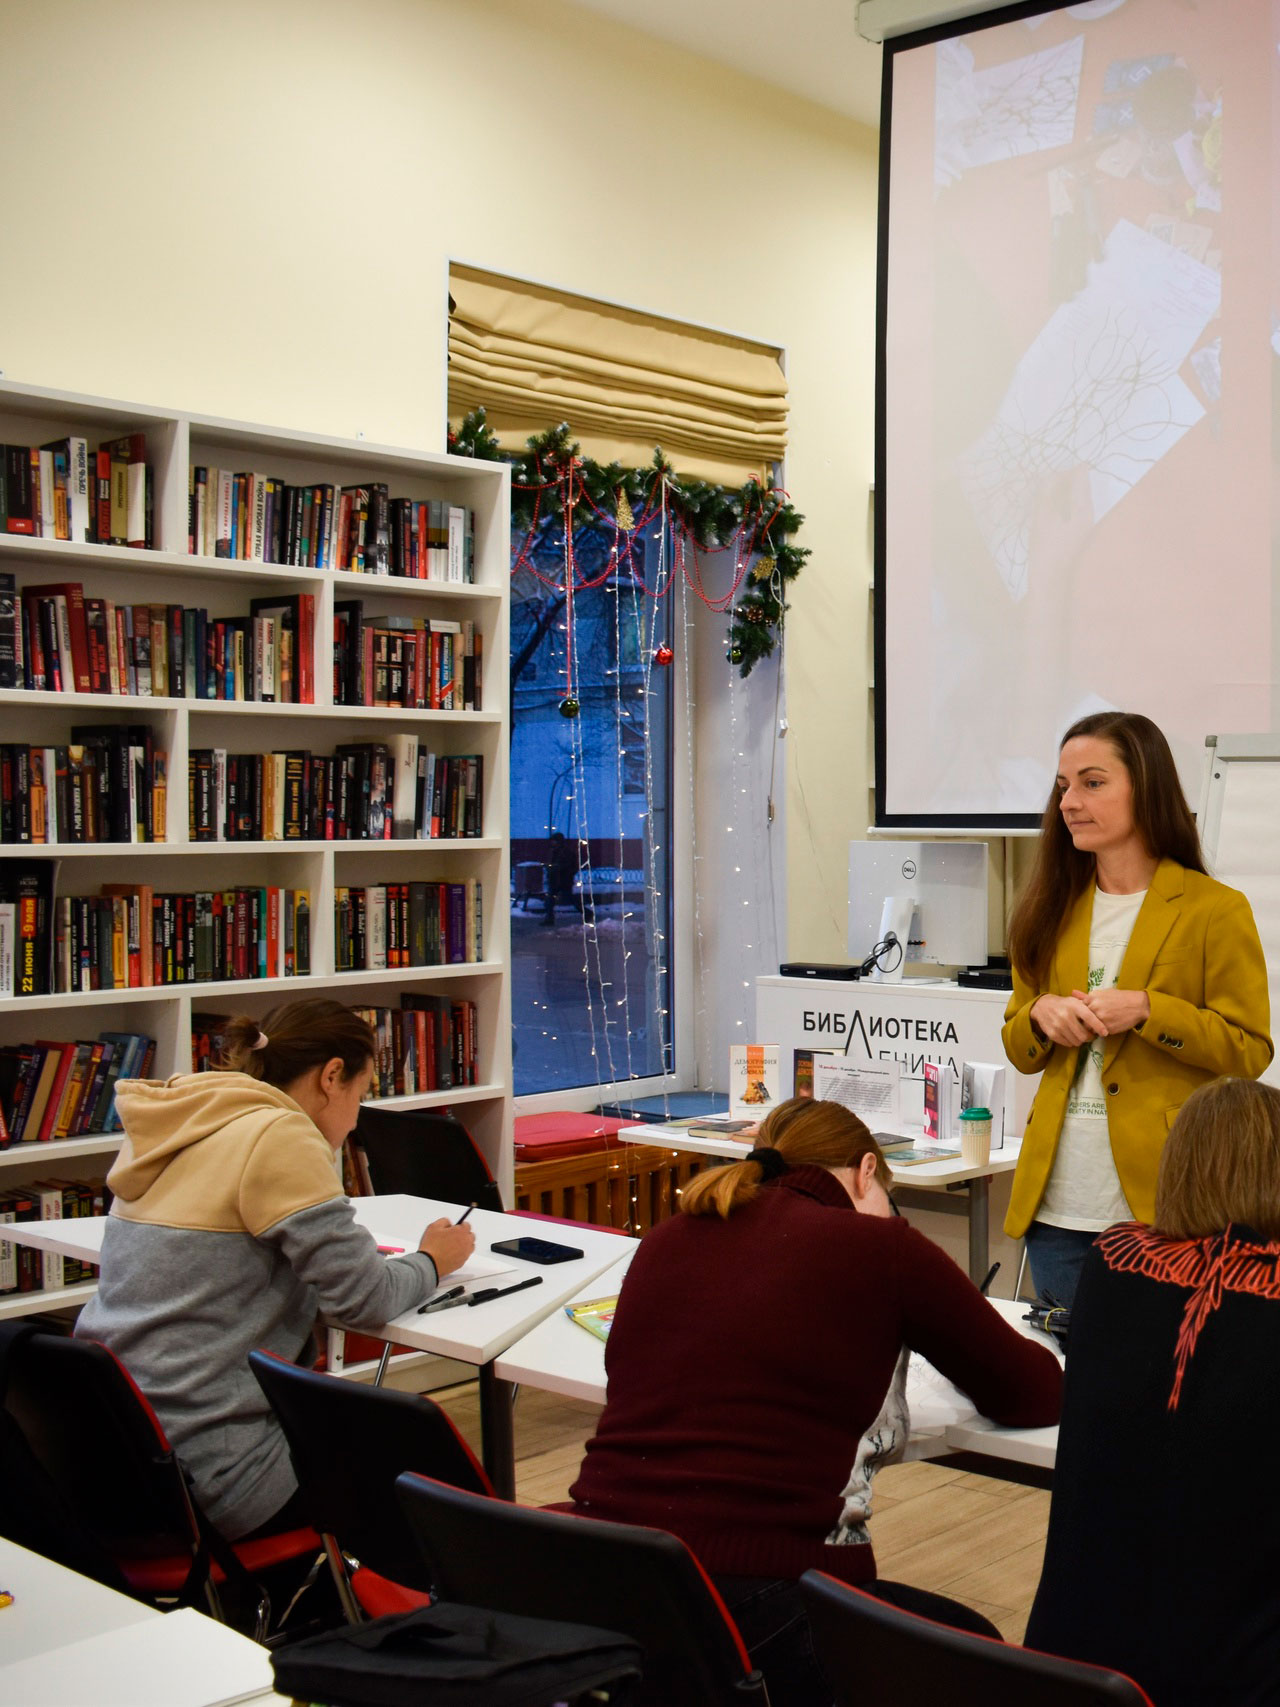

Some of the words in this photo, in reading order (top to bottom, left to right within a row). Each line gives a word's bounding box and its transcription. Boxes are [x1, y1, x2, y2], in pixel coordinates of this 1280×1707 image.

[76, 442, 86, 468] ВОЙНЫ
[78, 469, 86, 495] ГОРЕЧЬ
[256, 481, 264, 503] ВОЙНА
[255, 503, 263, 534] МИРОВАЯ
[121, 746, 129, 789] ВЕРМАХТ
[25, 899, 33, 923] мая
[23, 924, 33, 932] 9
[25, 942, 34, 975] июня
[22, 977, 33, 992] 22
[803, 1010, 959, 1059] БИБЛИОТЕКА
